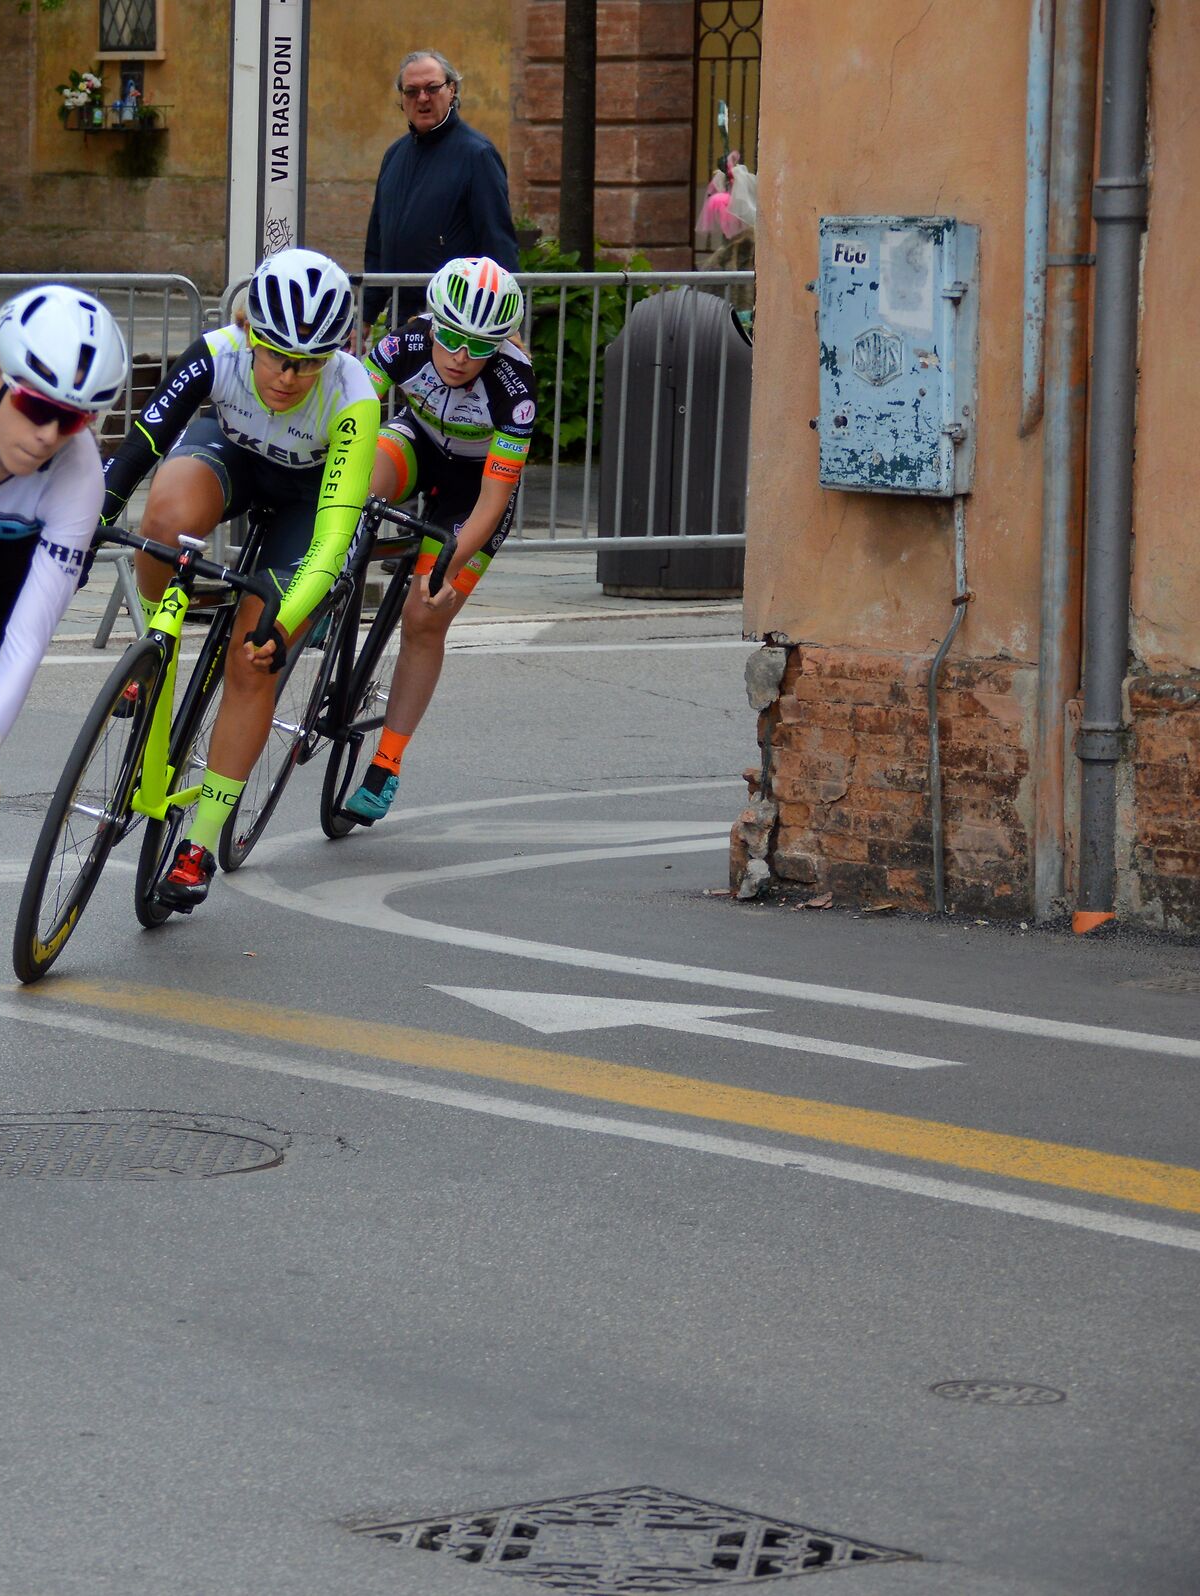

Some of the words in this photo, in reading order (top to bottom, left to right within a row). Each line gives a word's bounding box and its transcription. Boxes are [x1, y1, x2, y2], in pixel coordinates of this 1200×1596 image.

[272, 36, 292, 137] RASPONI
[271, 145, 289, 183] VIA
[159, 359, 208, 408] PISSEI
[493, 367, 518, 397] SERVICE
[498, 358, 516, 378] FORK
[512, 377, 529, 394] LIFT
[323, 439, 352, 499] PISSEI
